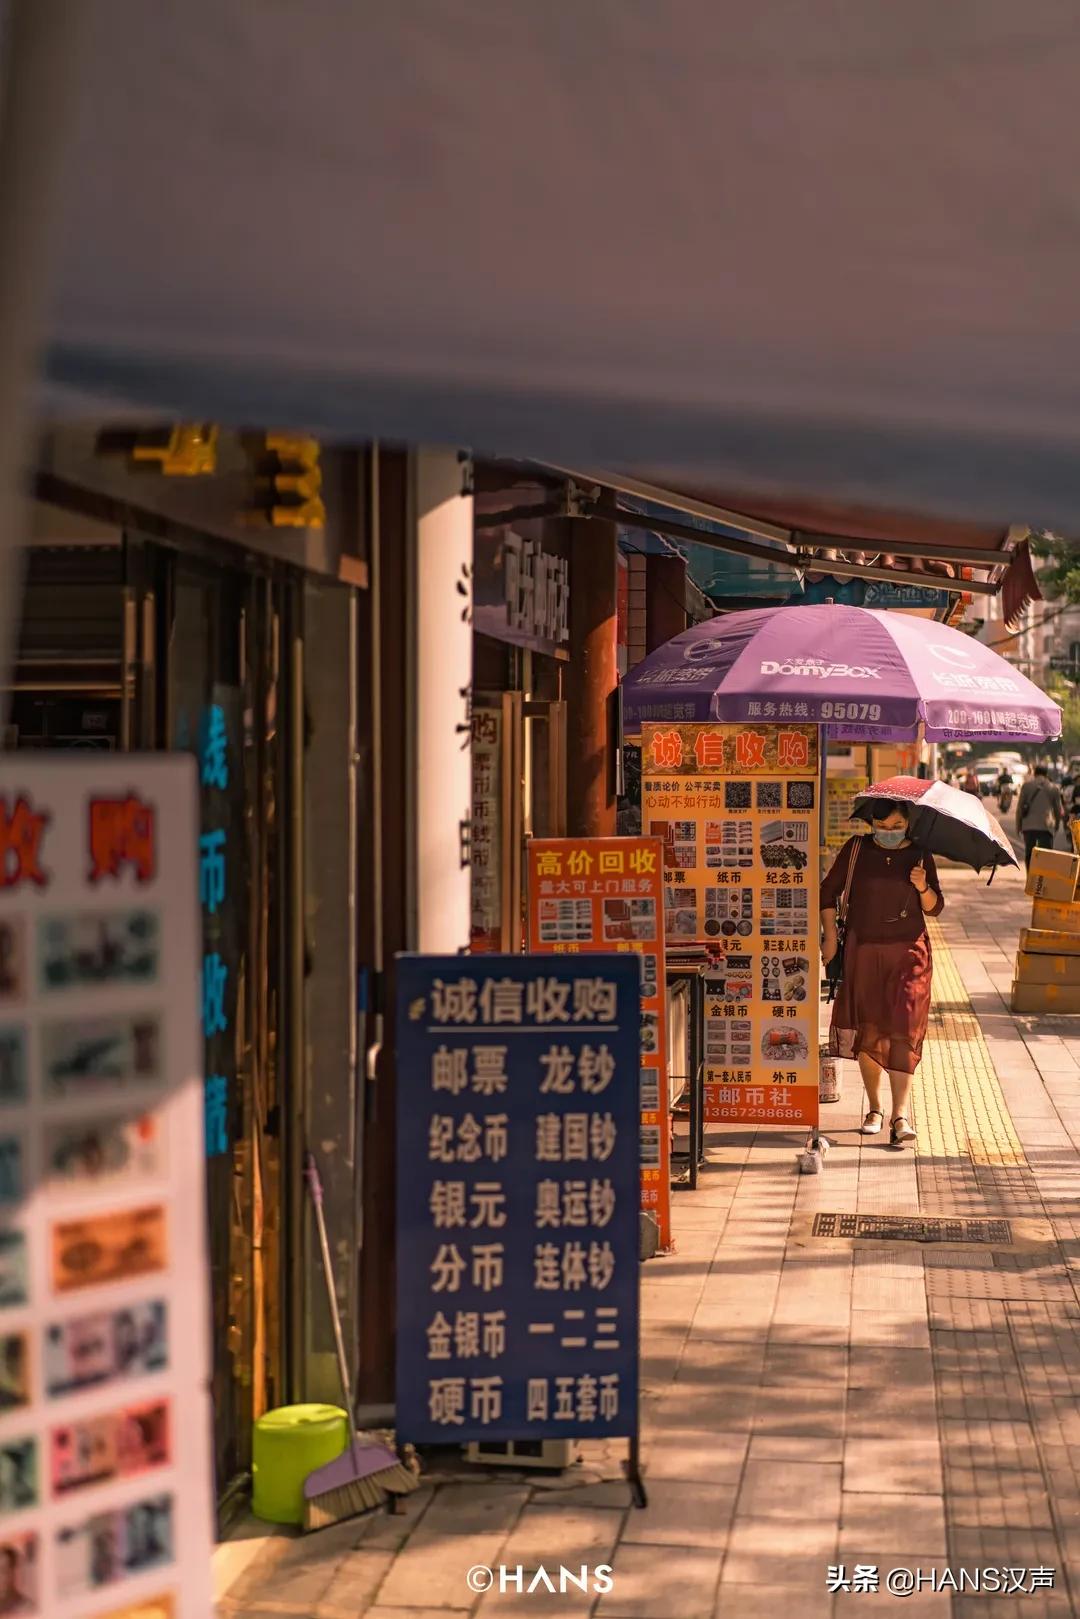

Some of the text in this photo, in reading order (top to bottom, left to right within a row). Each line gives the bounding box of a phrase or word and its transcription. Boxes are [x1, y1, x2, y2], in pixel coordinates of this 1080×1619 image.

[760, 661, 883, 680] DomyBox
[820, 701, 882, 721] 95079
[651, 730, 809, 768] 诚信收购
[684, 781, 721, 792] 公平买卖
[646, 794, 721, 809] 心动不如行动
[535, 848, 657, 876] 高价回收
[717, 871, 742, 884] 纸币
[766, 871, 804, 884] 纪念币
[763, 939, 806, 952] 第三套人民币
[430, 976, 618, 1024] 诚信收购
[711, 1005, 748, 1017] 金银币
[772, 1005, 797, 1018] 硬币
[431, 1044, 616, 1095] 邮票 龙钞
[706, 1070, 752, 1083] 第一套人民币
[772, 1071, 797, 1084] 外币
[704, 1107, 803, 1119] 13657298686
[428, 1111, 617, 1163] 纪念币 建国钞
[429, 1178, 616, 1229] 银元 奥运钞
[430, 1240, 616, 1293] 分币 连体钞
[426, 1306, 620, 1360] 金银币 一二三
[428, 1373, 620, 1426] 硬币 四五套币
